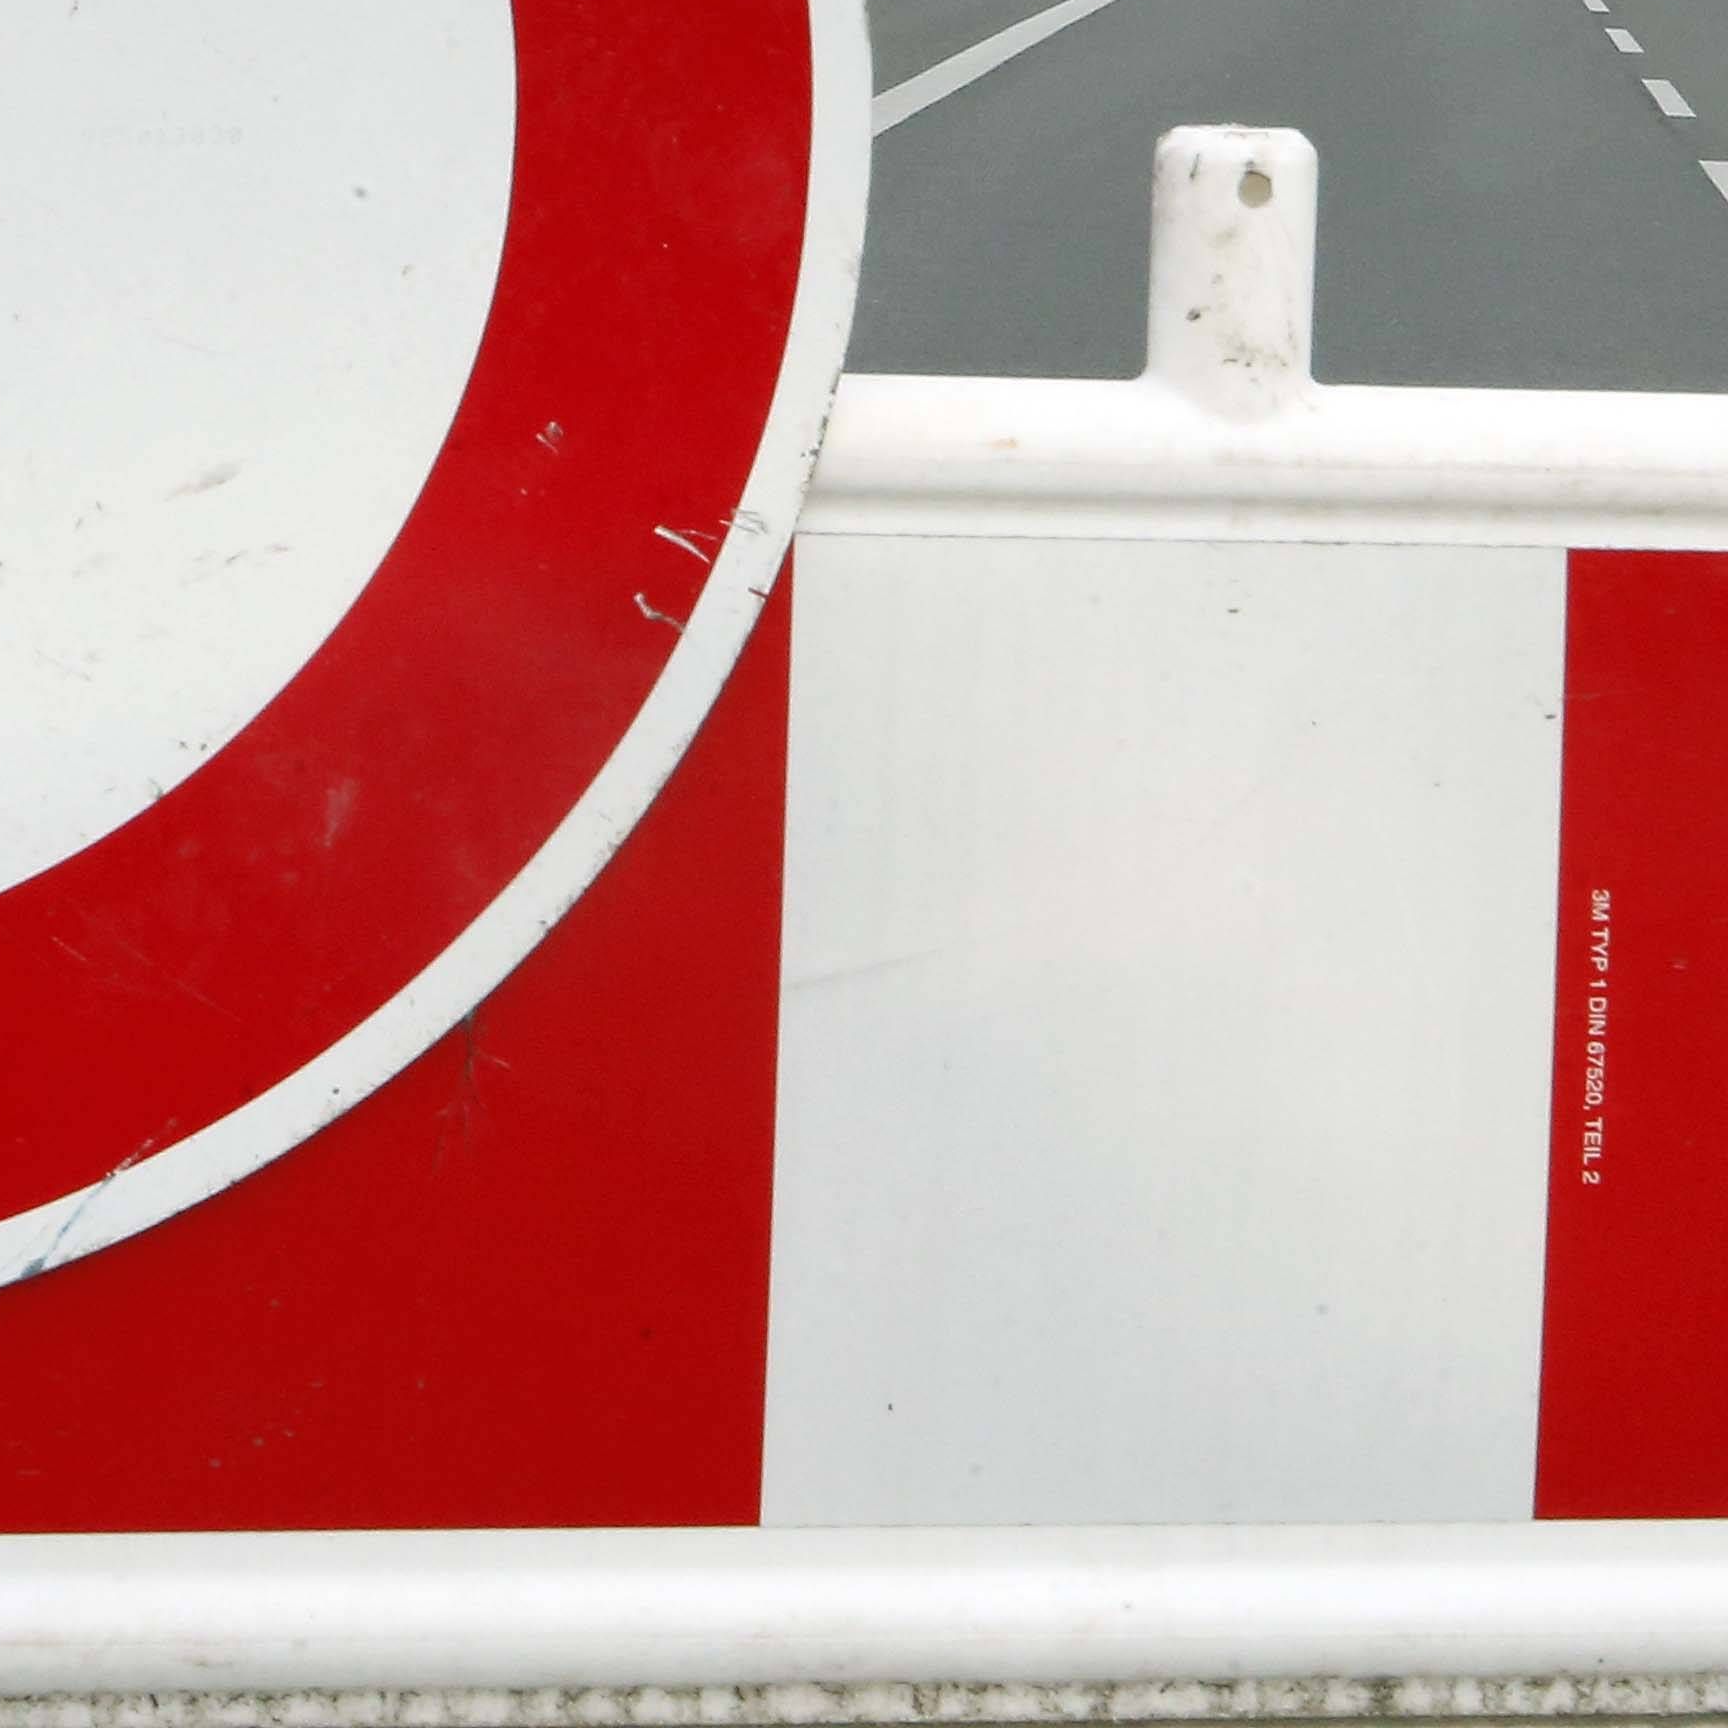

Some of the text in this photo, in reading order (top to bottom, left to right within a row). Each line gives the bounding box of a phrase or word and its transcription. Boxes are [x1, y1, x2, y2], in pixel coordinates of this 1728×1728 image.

[1582, 888, 1611, 1185] 3M TYP 1 DIN 67520, TEIL 2
